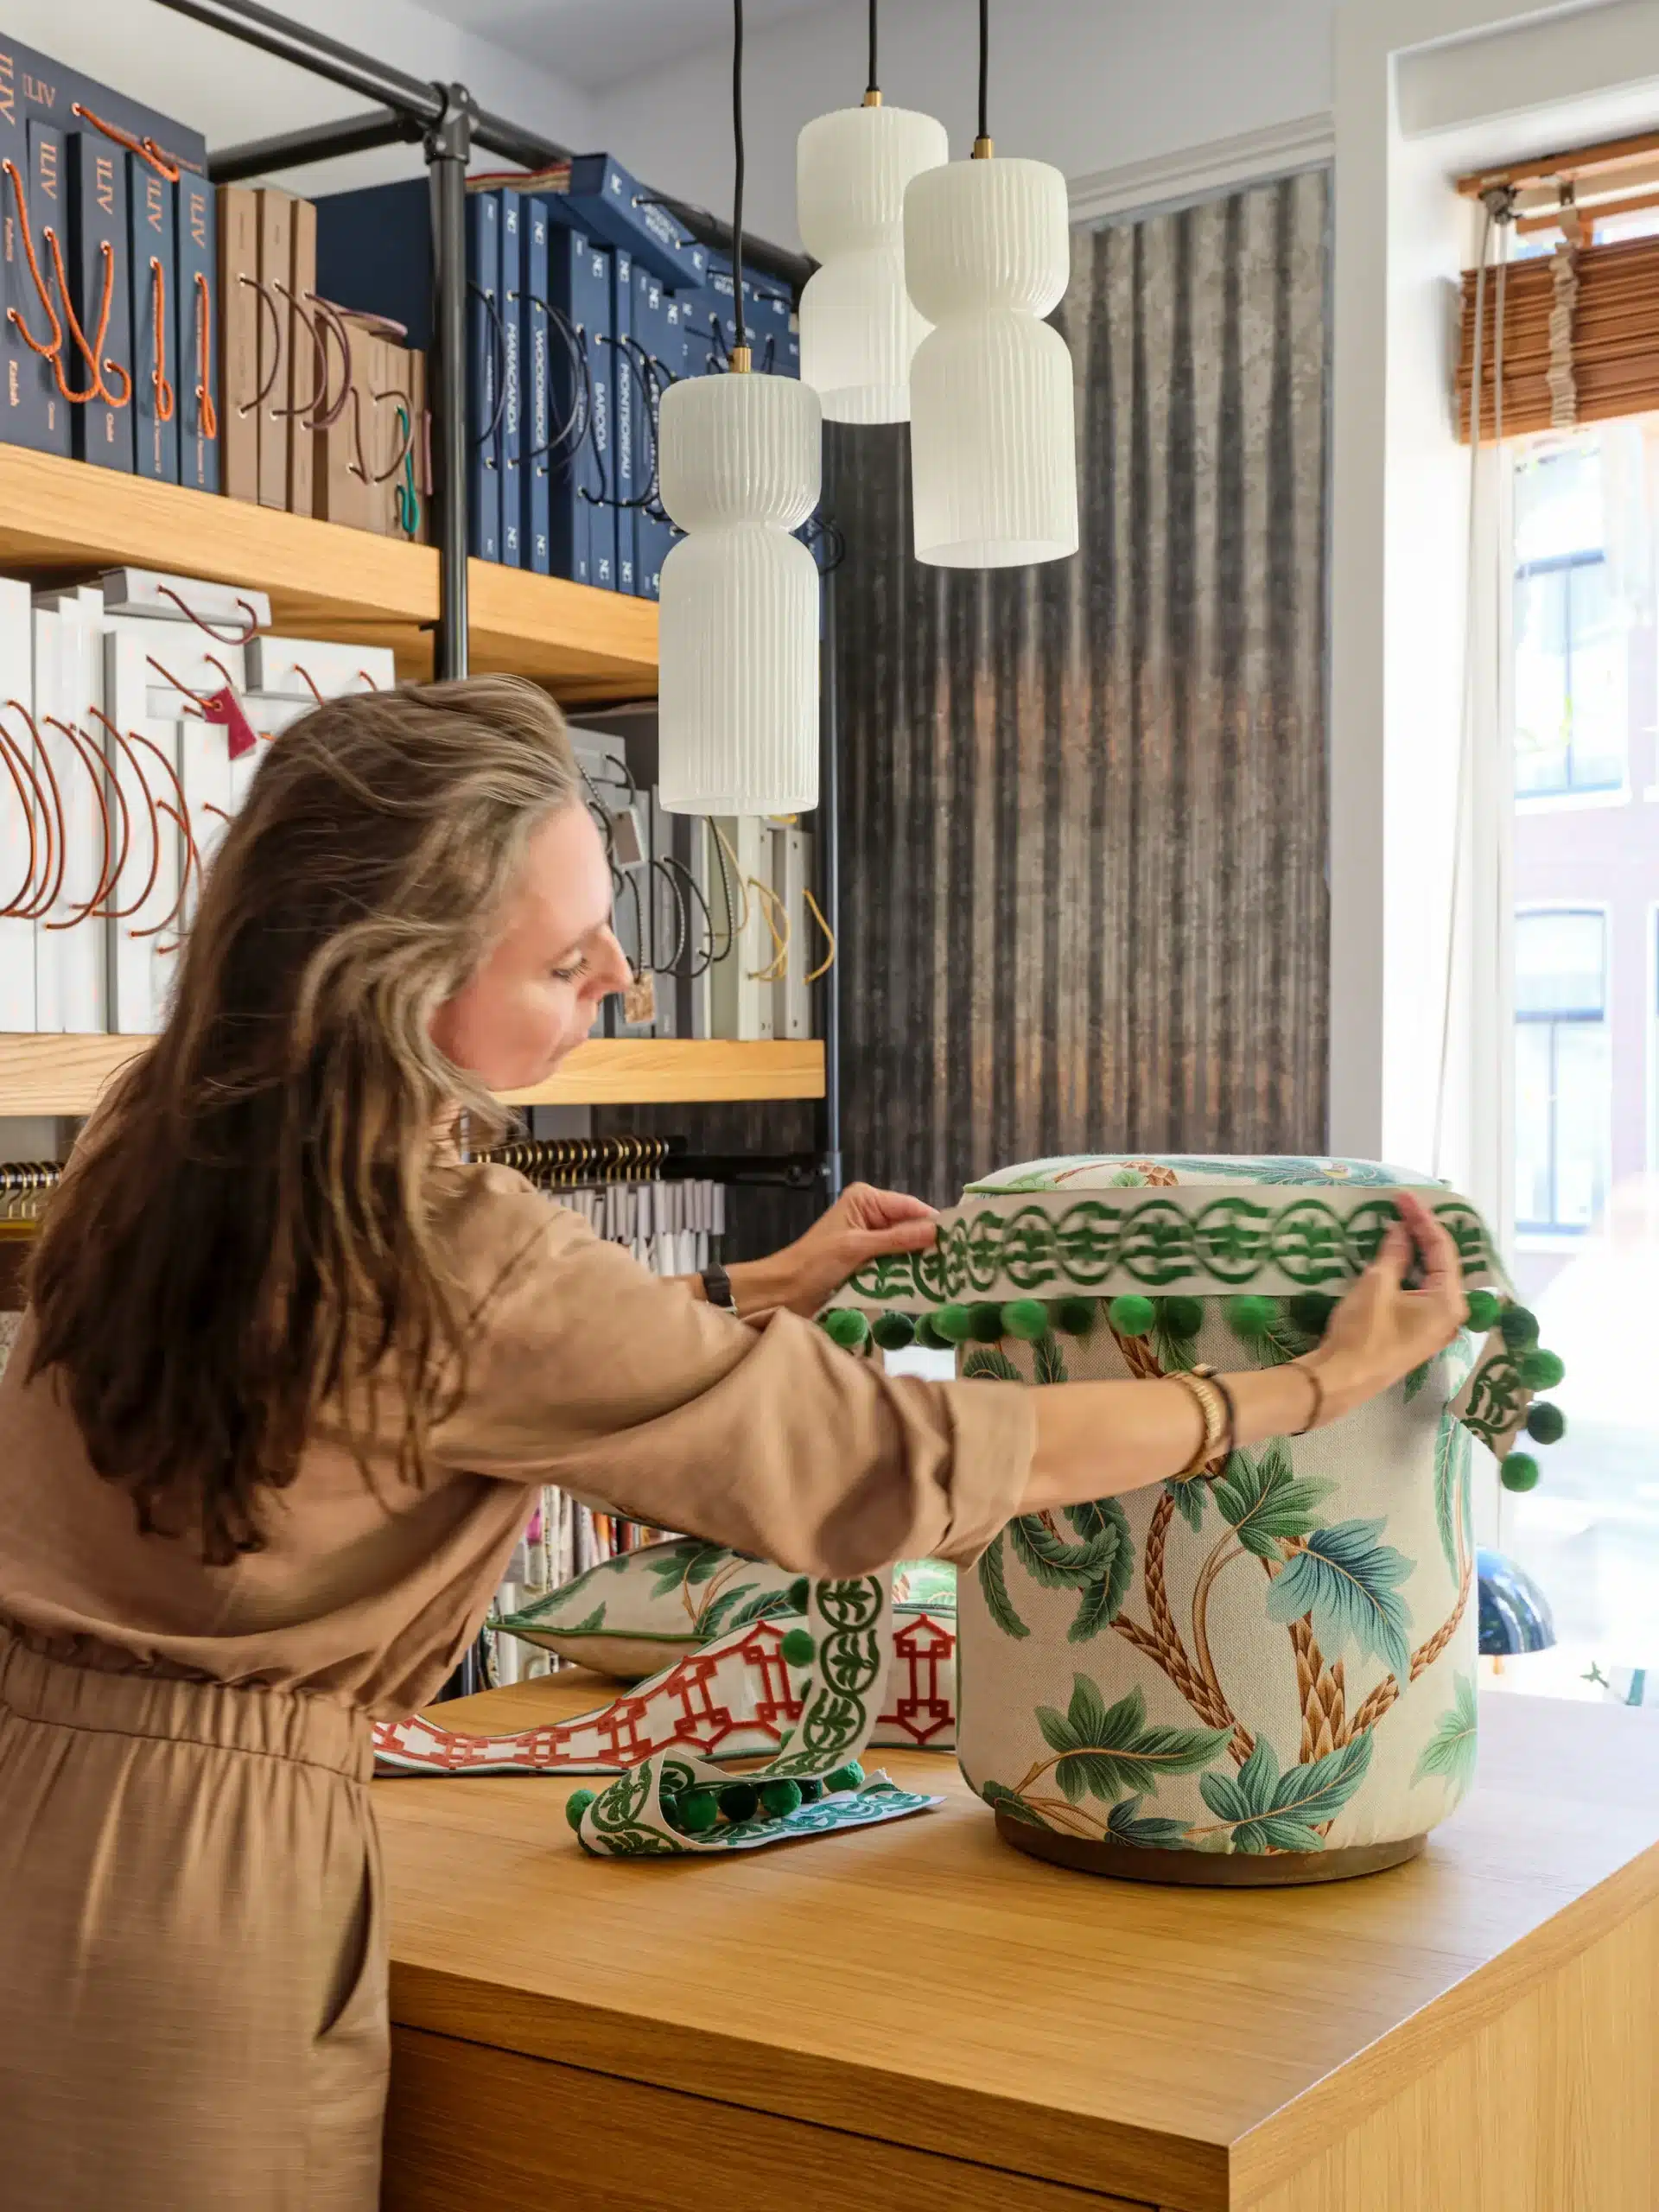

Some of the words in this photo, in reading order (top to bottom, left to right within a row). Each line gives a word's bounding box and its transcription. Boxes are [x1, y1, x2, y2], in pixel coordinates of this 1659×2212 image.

[22, 74, 56, 108] ILIV
[40, 142, 58, 200] ILIV
[96, 157, 113, 214] ILIV
[147, 177, 162, 232] ILIV
[191, 194, 206, 249] ILIV
[594, 382, 607, 451] BARODA
